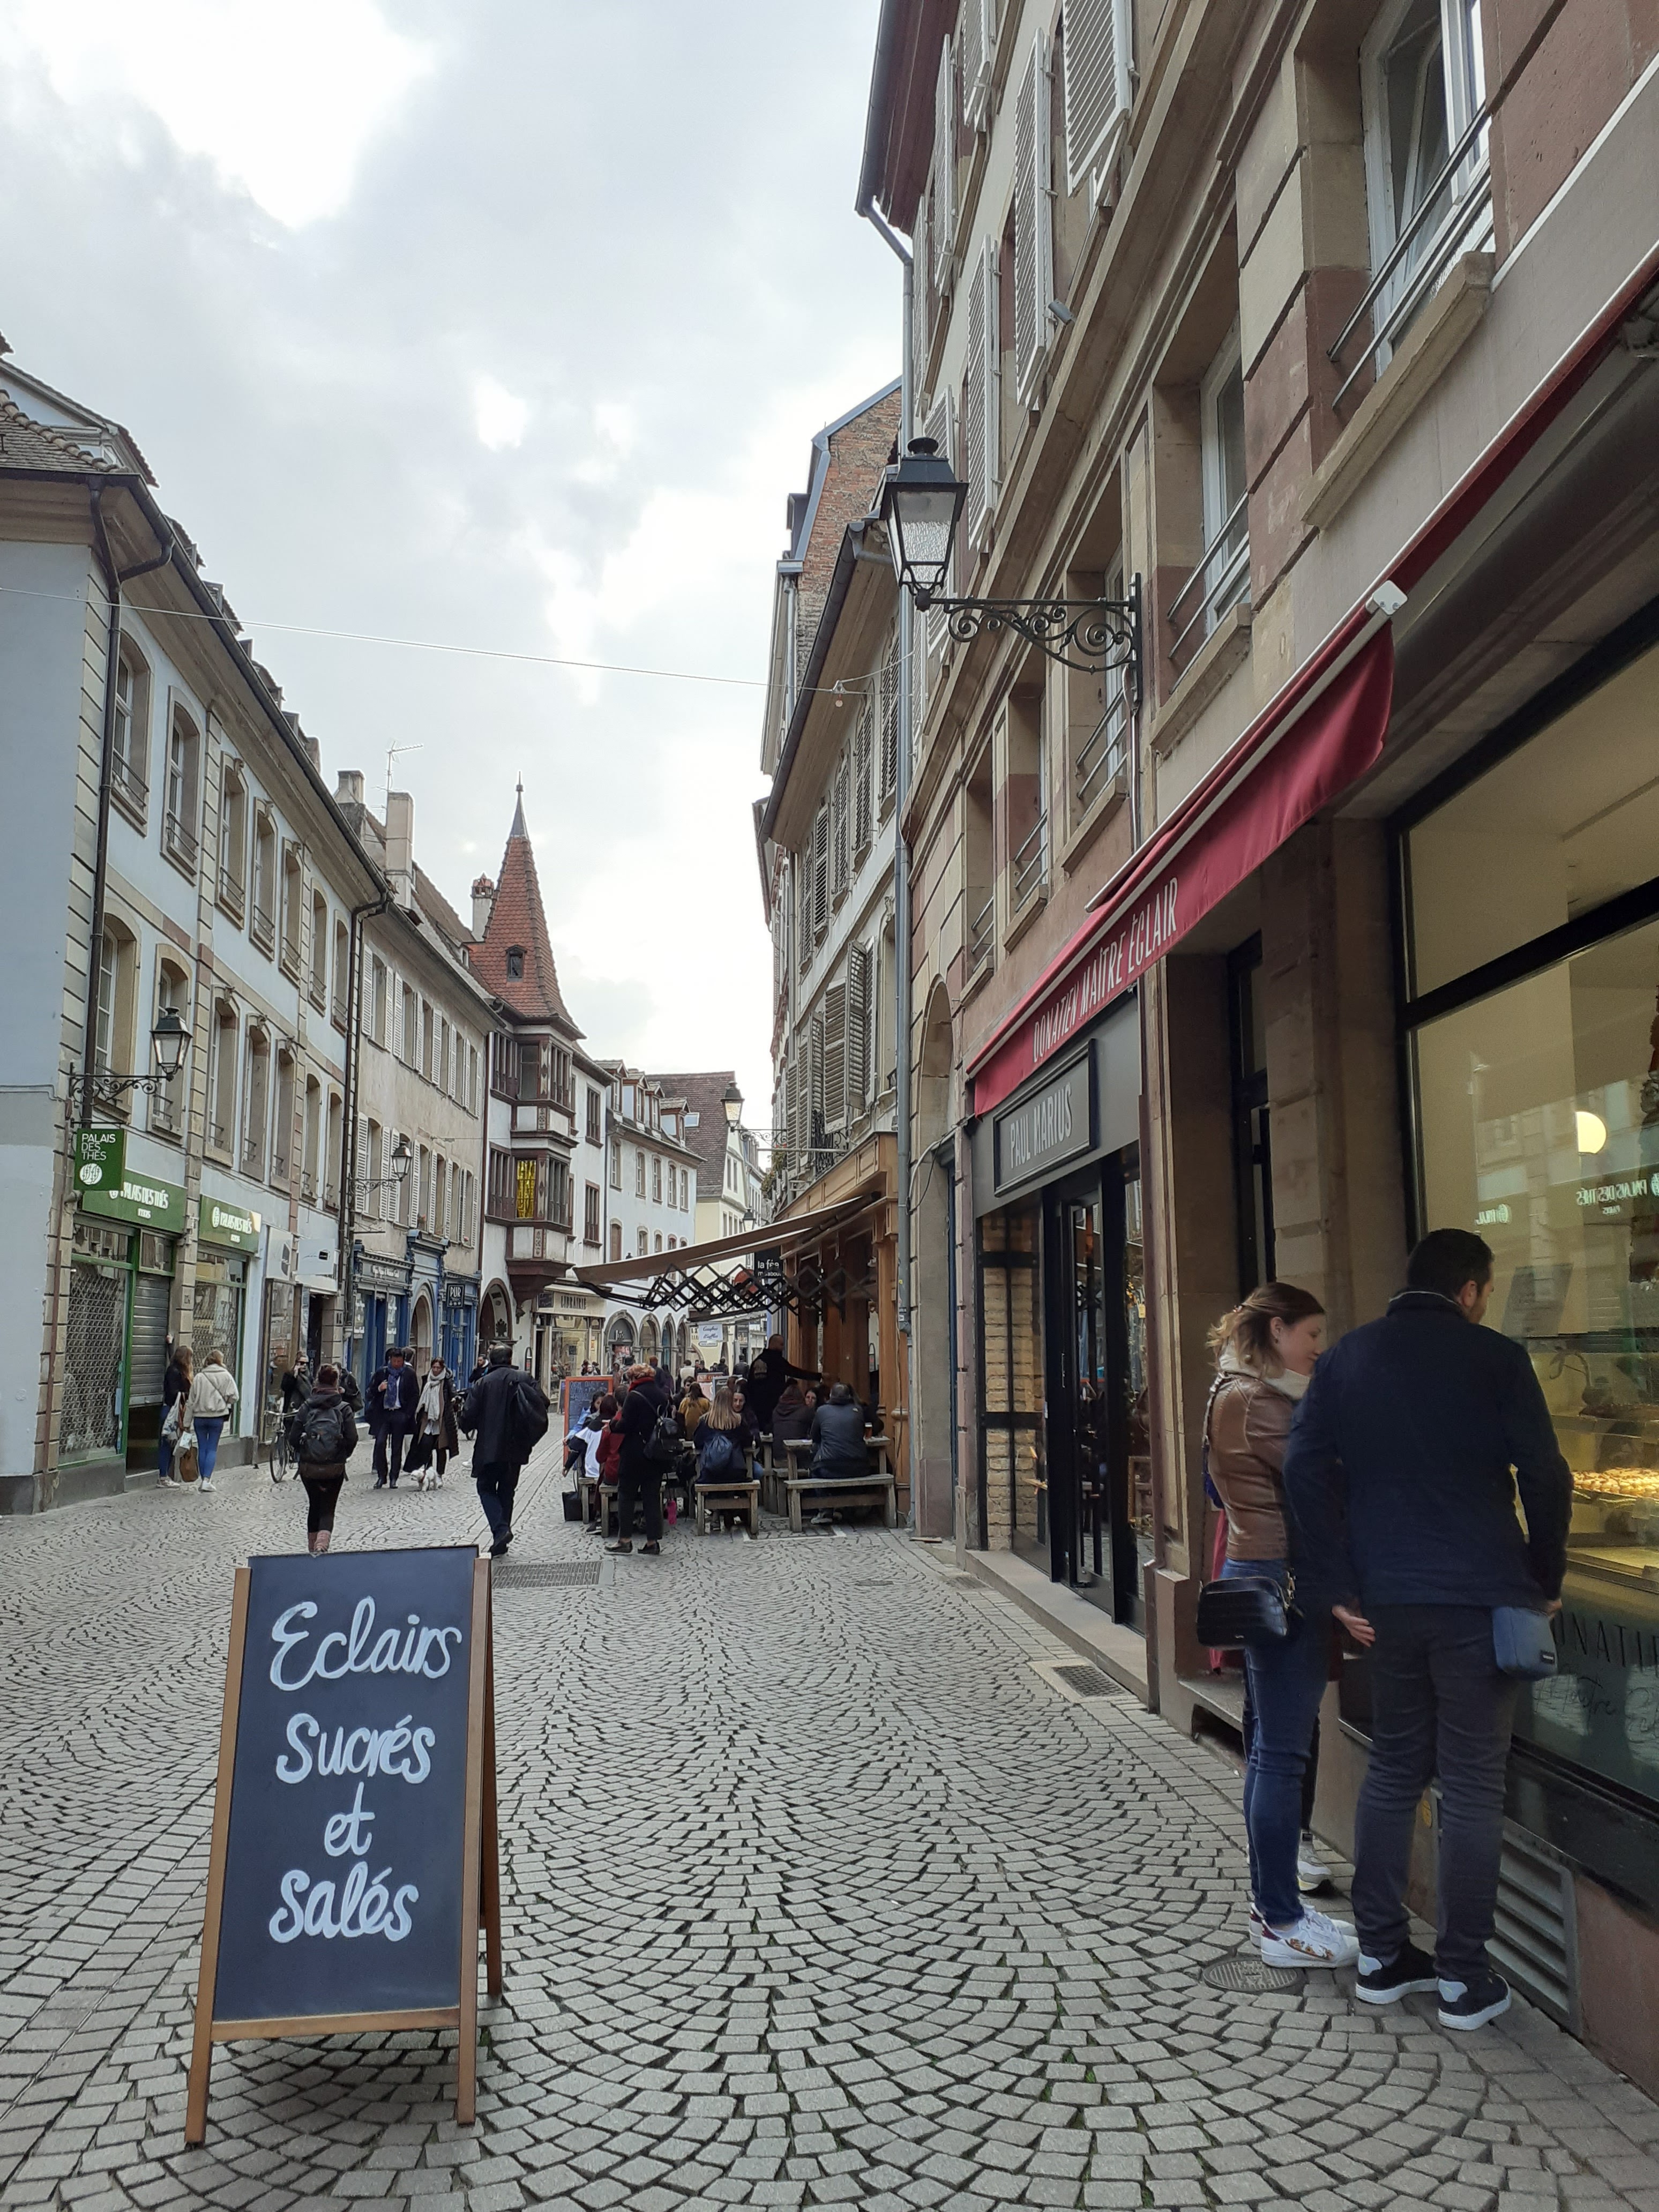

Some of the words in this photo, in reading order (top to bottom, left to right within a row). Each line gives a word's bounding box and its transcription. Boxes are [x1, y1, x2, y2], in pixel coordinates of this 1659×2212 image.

[1033, 981, 1079, 1063] DONATIEN
[1080, 931, 1126, 1018] MAÎTRE
[1127, 877, 1178, 974] ÉCLAIR
[81, 1142, 101, 1152] DES
[82, 1133, 116, 1143] PALAIS
[1011, 1114, 1030, 1169] PAUL
[1034, 1083, 1072, 1156] MARIUS
[141, 1187, 154, 1205] DES
[758, 1260, 765, 1269] la
[450, 1287, 461, 1297] PUR
[561, 1296, 587, 1310] LIBRAIRIE
[270, 1596, 462, 1691] Eclairs
[276, 1713, 435, 1784] Sucrés
[324, 1781, 376, 1857] et
[269, 1861, 419, 1944] Salés
